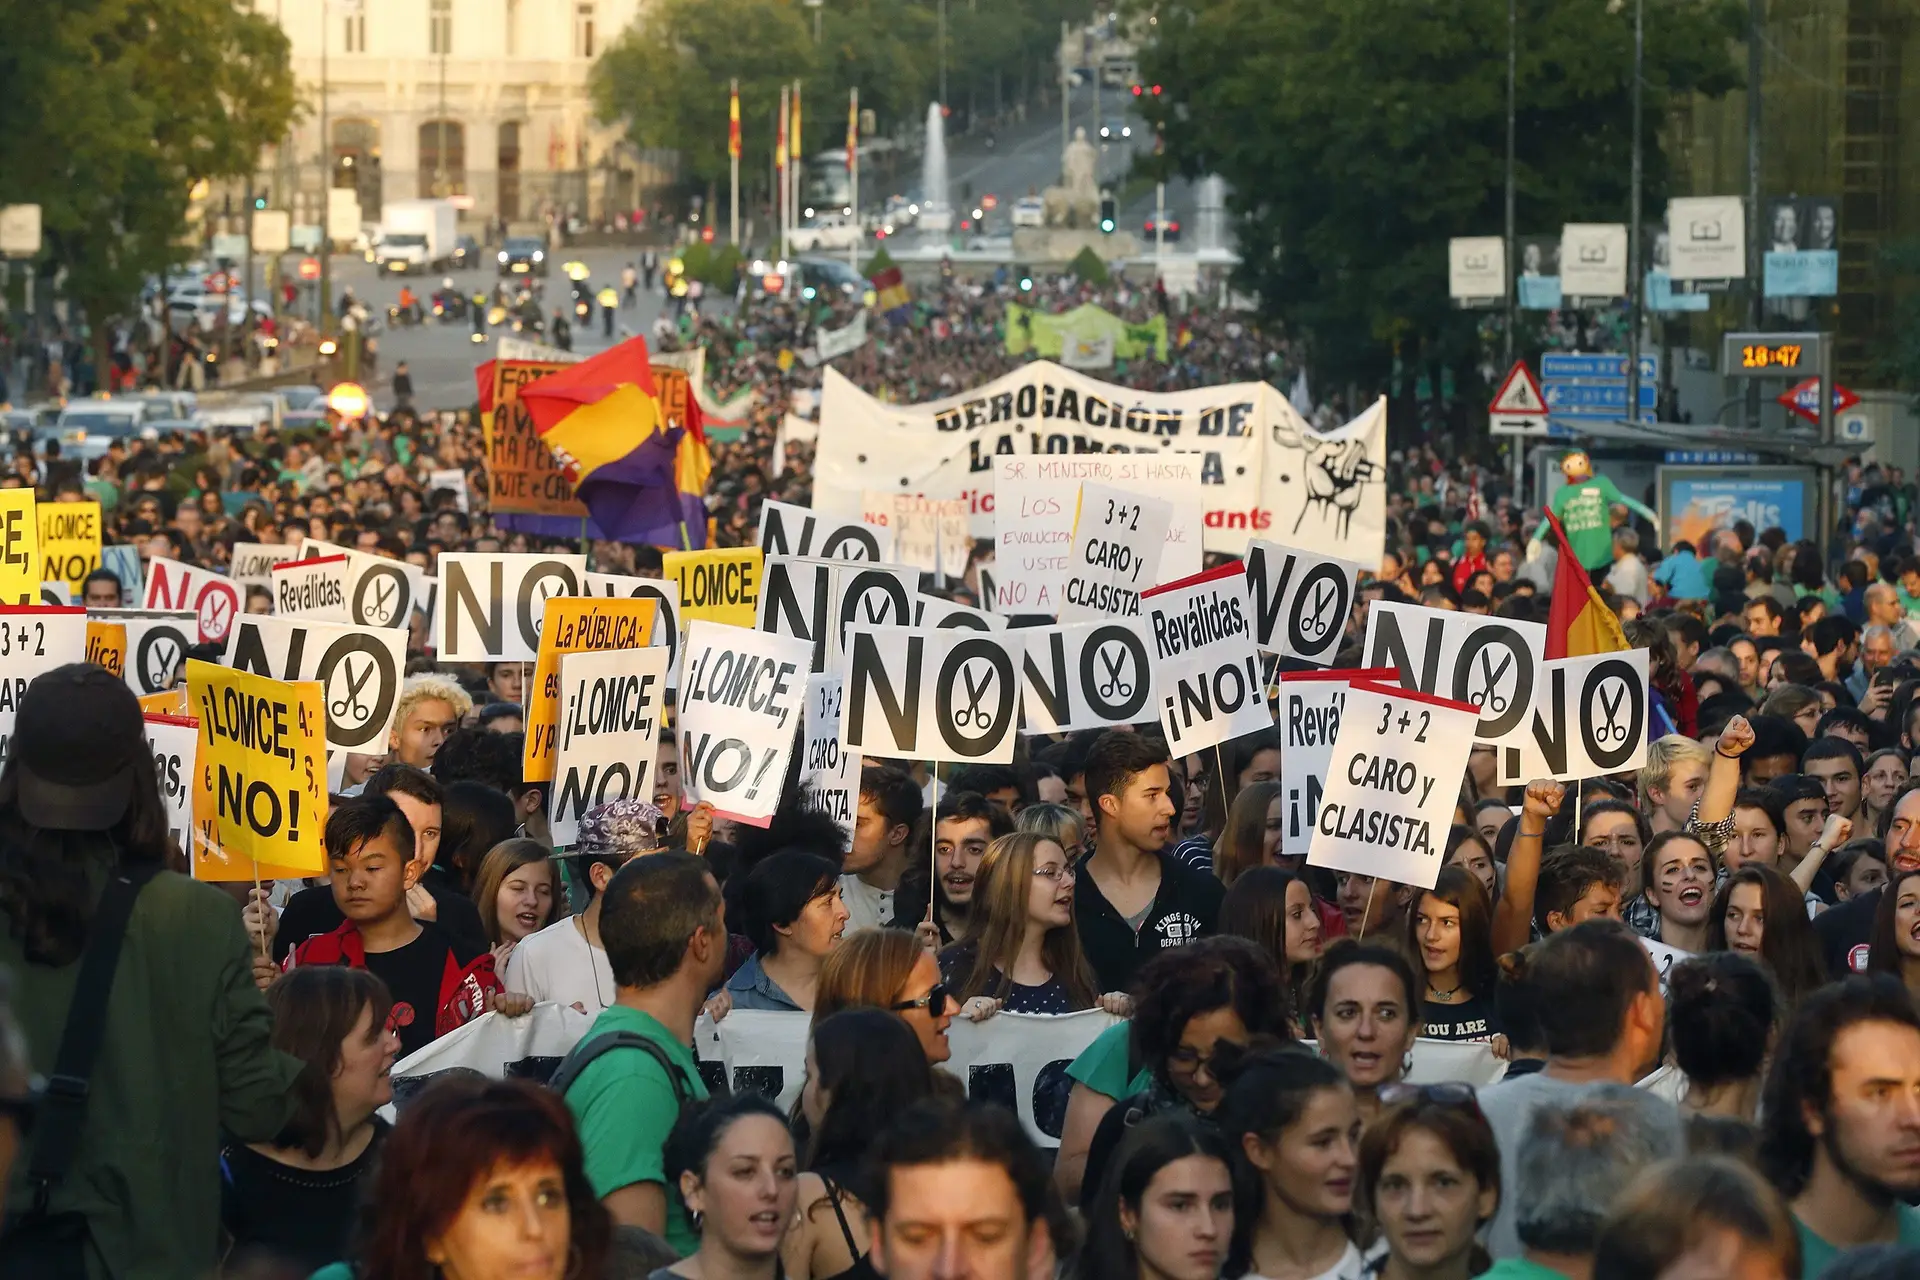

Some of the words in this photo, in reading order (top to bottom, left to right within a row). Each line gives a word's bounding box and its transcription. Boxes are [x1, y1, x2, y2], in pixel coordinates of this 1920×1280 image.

[934, 384, 1183, 436] DEROGACIÓN
[1198, 402, 1254, 438] DE
[1004, 463, 1028, 480] SR.
[1039, 463, 1113, 481] MINISTRO,
[1120, 464, 1139, 479] SI
[1147, 464, 1192, 480] HASTA
[42, 514, 97, 547] ¡LOMCE,
[762, 507, 880, 562] NO
[1021, 496, 1062, 519] LOS
[1205, 506, 1273, 531] ants
[1004, 528, 1073, 545] EVOLUCION
[1085, 538, 1131, 572] CARO
[1131, 556, 1144, 582] y
[43, 554, 97, 582] NO!
[675, 562, 758, 612] LOMCE,
[1023, 557, 1068, 572] USTE
[147, 562, 239, 643] NO
[280, 575, 346, 614] Reválidas,
[445, 560, 580, 656] NO
[763, 564, 911, 674] NO
[999, 580, 1028, 607] NO
[1036, 584, 1050, 607] A
[1067, 577, 1144, 617] CLASISTA.
[1246, 546, 1349, 656] NO
[556, 615, 574, 649] La
[576, 607, 643, 649] PÚBLICA:
[1151, 591, 1250, 660] Reválidas,
[232, 622, 397, 747] NO
[682, 646, 798, 729] ¡LOMCE,
[846, 632, 1016, 757] NO
[1020, 625, 1151, 730] NO
[1165, 655, 1261, 742] ¡NO!
[1370, 610, 1534, 739] NO
[202, 684, 296, 771] ¡LOMCE,
[564, 675, 655, 752] ¡LOMCE,
[1506, 659, 1644, 779] NO
[532, 723, 545, 759] y
[544, 725, 556, 759] p
[682, 730, 779, 801] NO!
[808, 737, 840, 771] CARO
[841, 751, 849, 779] y
[218, 763, 300, 842] NO!
[554, 759, 648, 823] NO!
[1348, 752, 1417, 795] CARO
[1417, 775, 1436, 809] y
[1320, 803, 1436, 857] CLASISTA.
[1184, 913, 1202, 931] GYM
[1455, 1018, 1487, 1036] ARE
